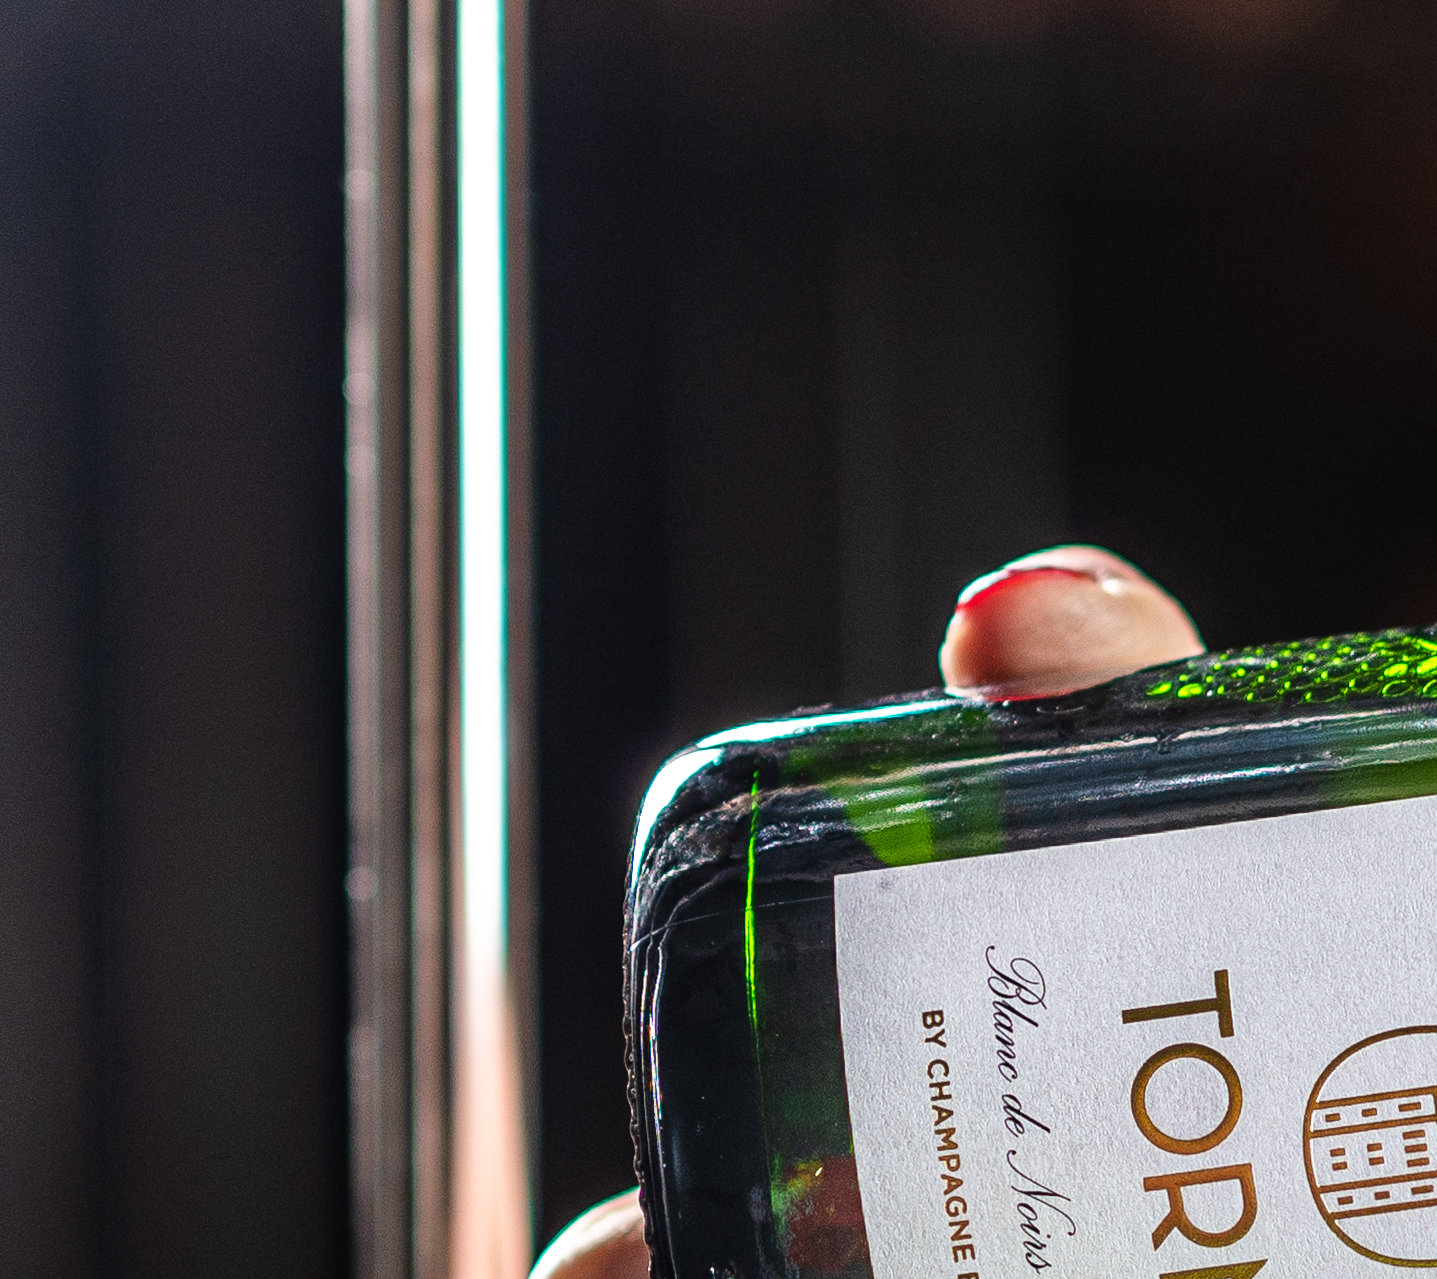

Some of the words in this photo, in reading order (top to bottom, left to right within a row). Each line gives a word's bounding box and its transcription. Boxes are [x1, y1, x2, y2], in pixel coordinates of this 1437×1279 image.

[921, 1009, 947, 1048] BY
[985, 945, 1048, 1083] Blanc
[926, 1058, 977, 1264] CHAMPAGNE
[1001, 1093, 1051, 1138] de
[1006, 1149, 1077, 1275] Noirs
